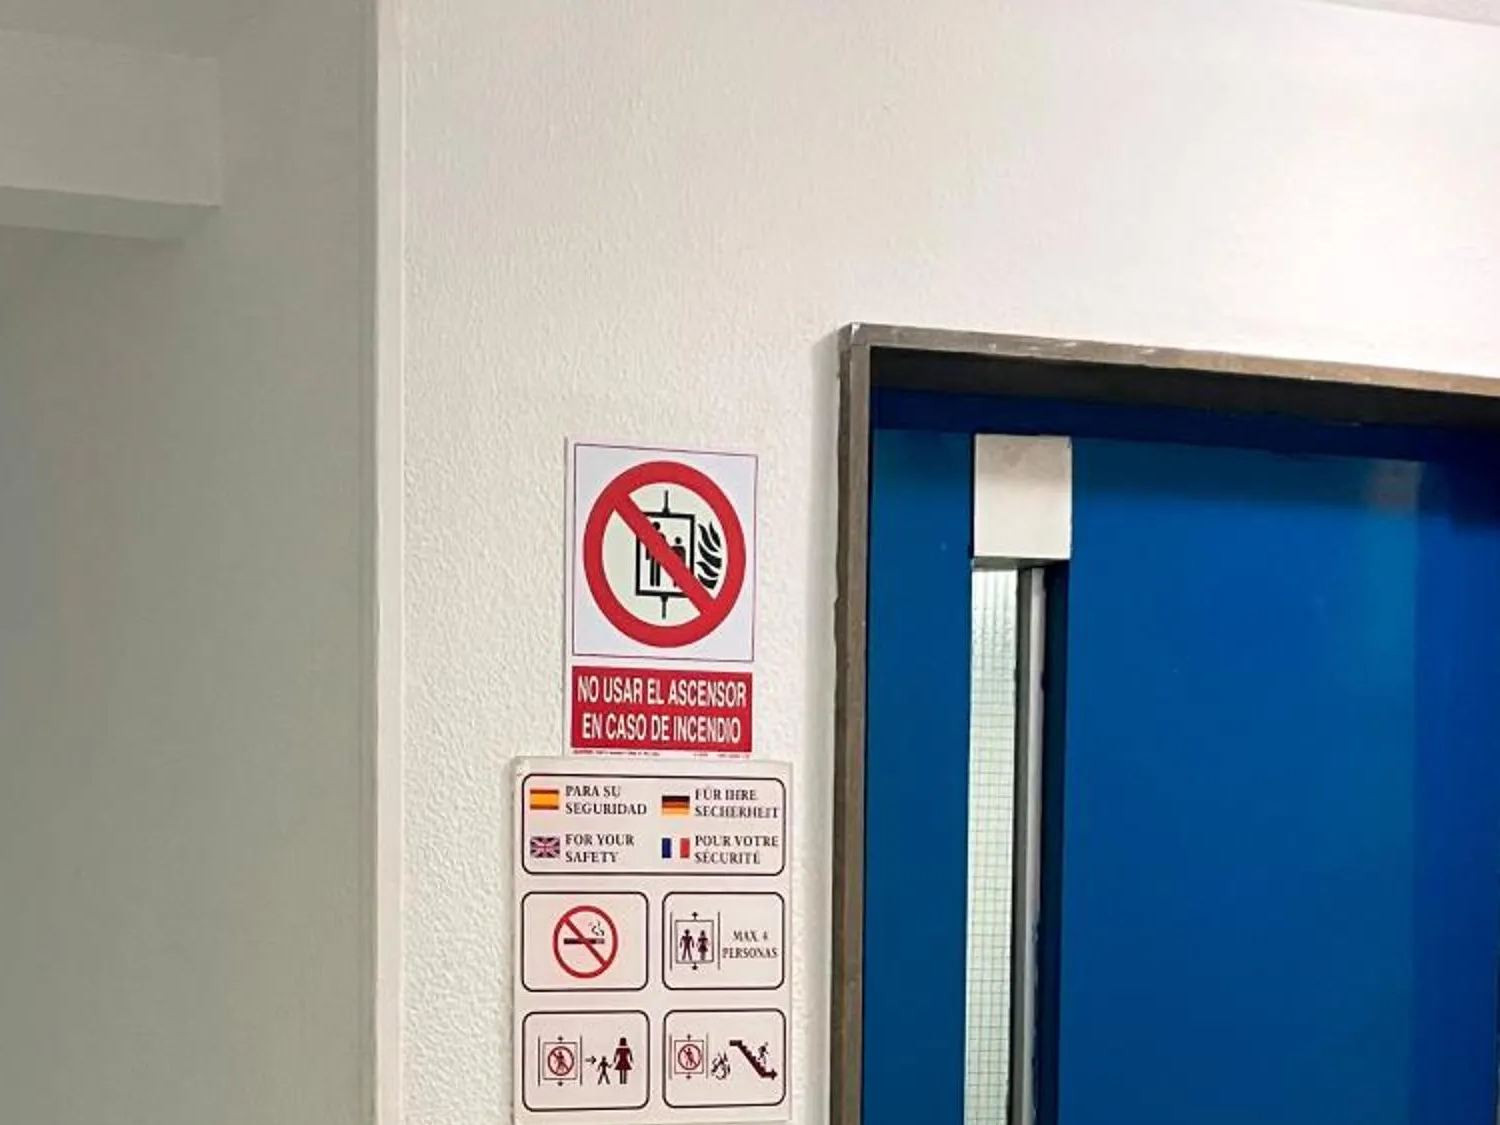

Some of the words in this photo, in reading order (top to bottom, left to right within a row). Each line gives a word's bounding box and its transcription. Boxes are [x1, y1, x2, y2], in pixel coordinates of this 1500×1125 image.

[577, 675, 599, 703] NO
[603, 676, 643, 704] USAR
[647, 678, 665, 705] EL
[668, 679, 747, 708] ASCENSOR
[582, 712, 603, 739] EN
[605, 713, 647, 741] CASO
[651, 714, 670, 741] DE
[673, 716, 741, 744] INCENDIO
[565, 785, 600, 797] PARA
[603, 785, 621, 798] SU
[695, 786, 722, 801] FÜR
[725, 789, 758, 801] IHRE
[565, 802, 648, 815] SEGURIDAD
[565, 833, 593, 846] FOR
[596, 833, 635, 846] YOUR
[695, 835, 731, 847] POUR
[733, 835, 780, 847] VOTRE
[565, 851, 619, 863] SAFETY
[722, 947, 779, 959] PERSONAS
